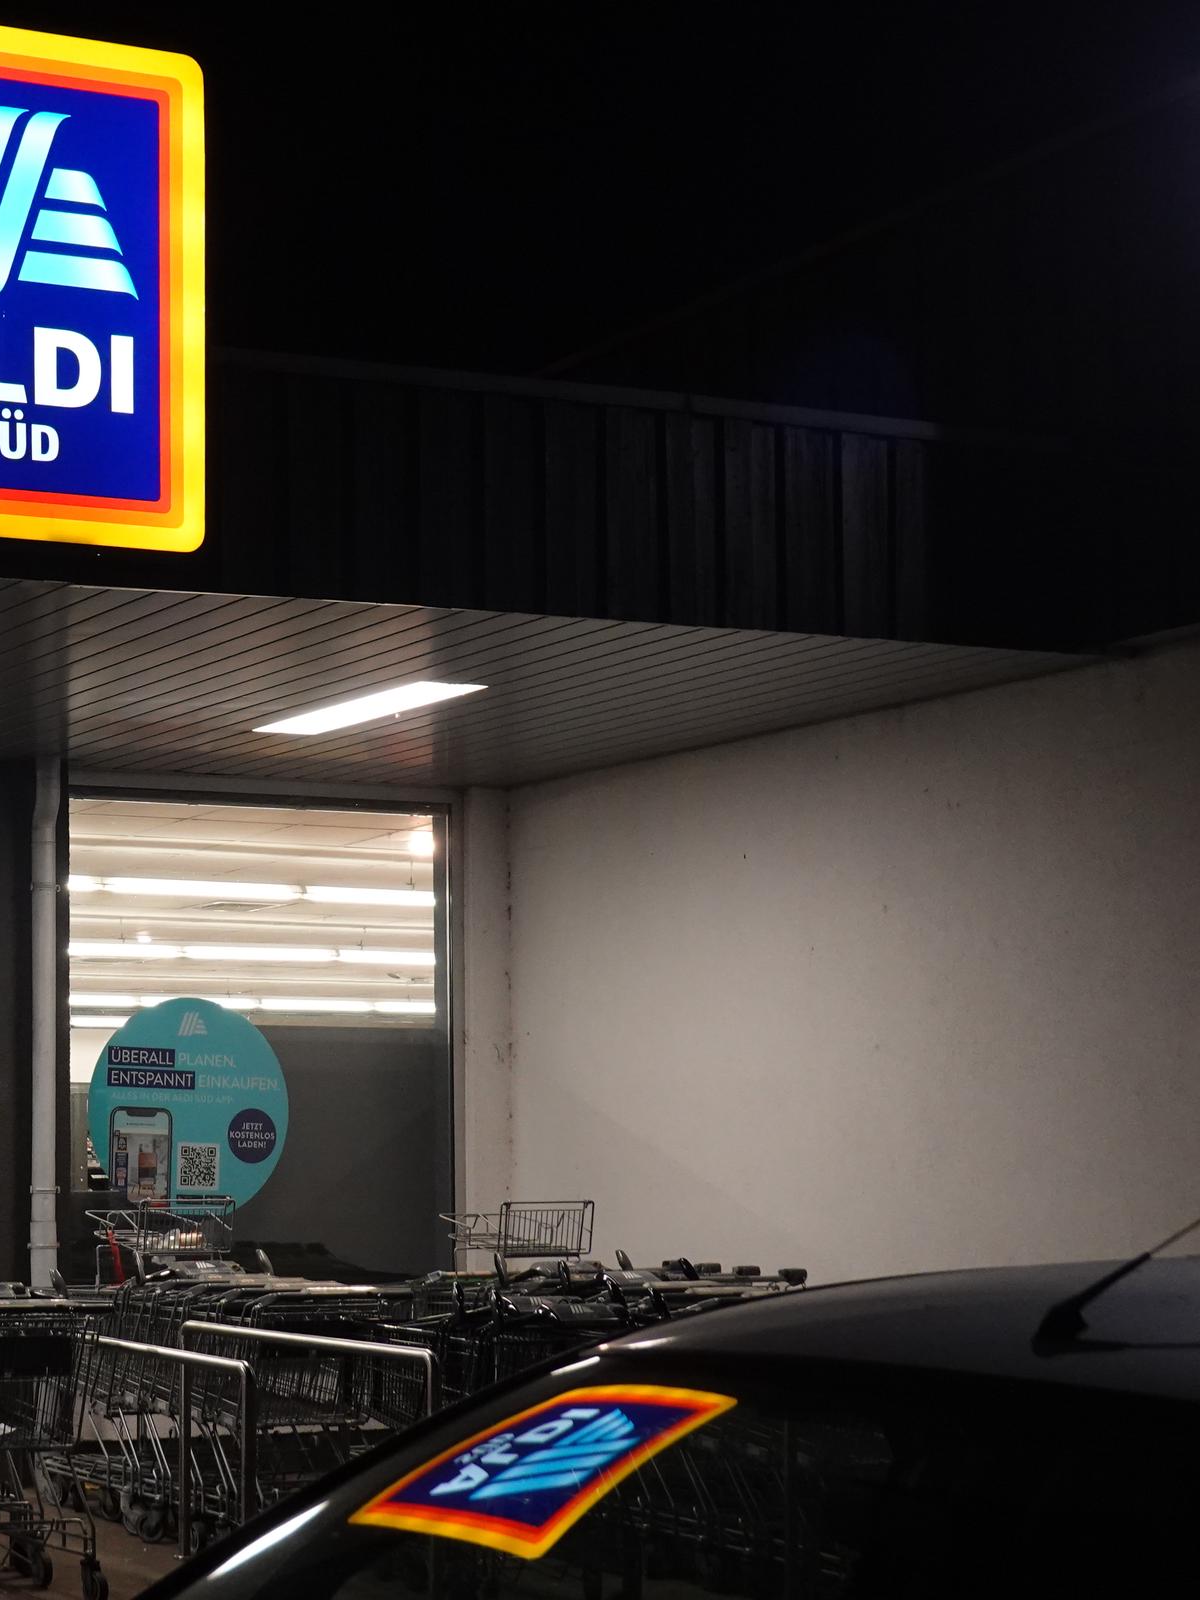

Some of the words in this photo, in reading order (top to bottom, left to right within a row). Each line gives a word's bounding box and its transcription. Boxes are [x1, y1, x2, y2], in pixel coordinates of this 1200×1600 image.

[111, 1046, 173, 1065] ÜBERALL
[178, 1052, 237, 1068] PLANEN.
[111, 1071, 193, 1087] ENTSPANNT
[242, 1122, 263, 1131] JETZT
[229, 1130, 275, 1140] KOSTENLOS
[237, 1140, 267, 1149] LADEN!
